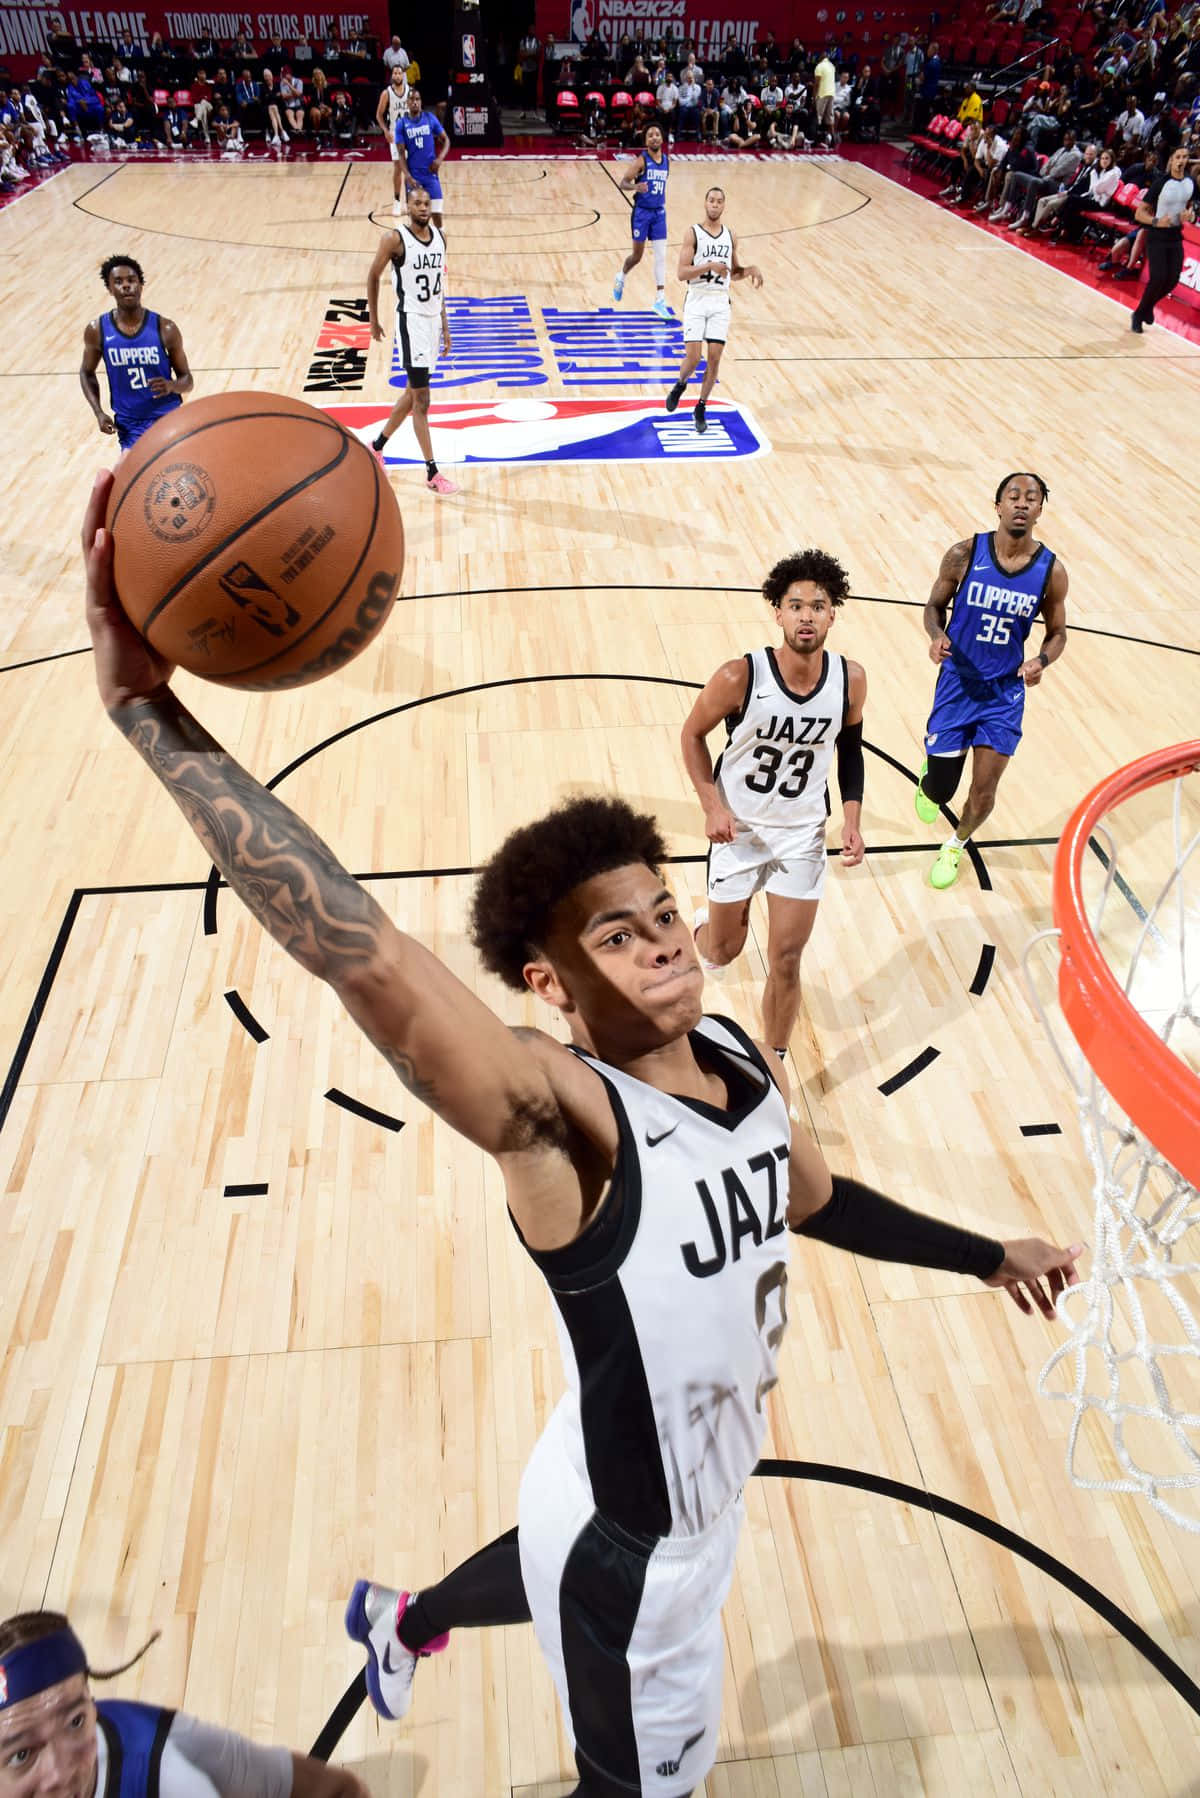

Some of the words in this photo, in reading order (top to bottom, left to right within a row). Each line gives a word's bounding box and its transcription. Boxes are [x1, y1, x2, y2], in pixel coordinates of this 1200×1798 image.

[600, 1, 686, 17] NBA2K24
[258, 14, 300, 40] STARS
[651, 181, 664, 195] 34
[413, 253, 442, 270] JAZZ
[703, 245, 730, 258] JAZZ
[415, 272, 441, 303] 34
[108, 346, 160, 366] CLIPPERS
[303, 299, 371, 392] NBA2K24
[127, 367, 148, 389] 21
[966, 581, 1038, 618] CLIPPERS
[976, 613, 1014, 645] 35
[756, 715, 832, 745] JAZZ
[745, 745, 815, 798] 33
